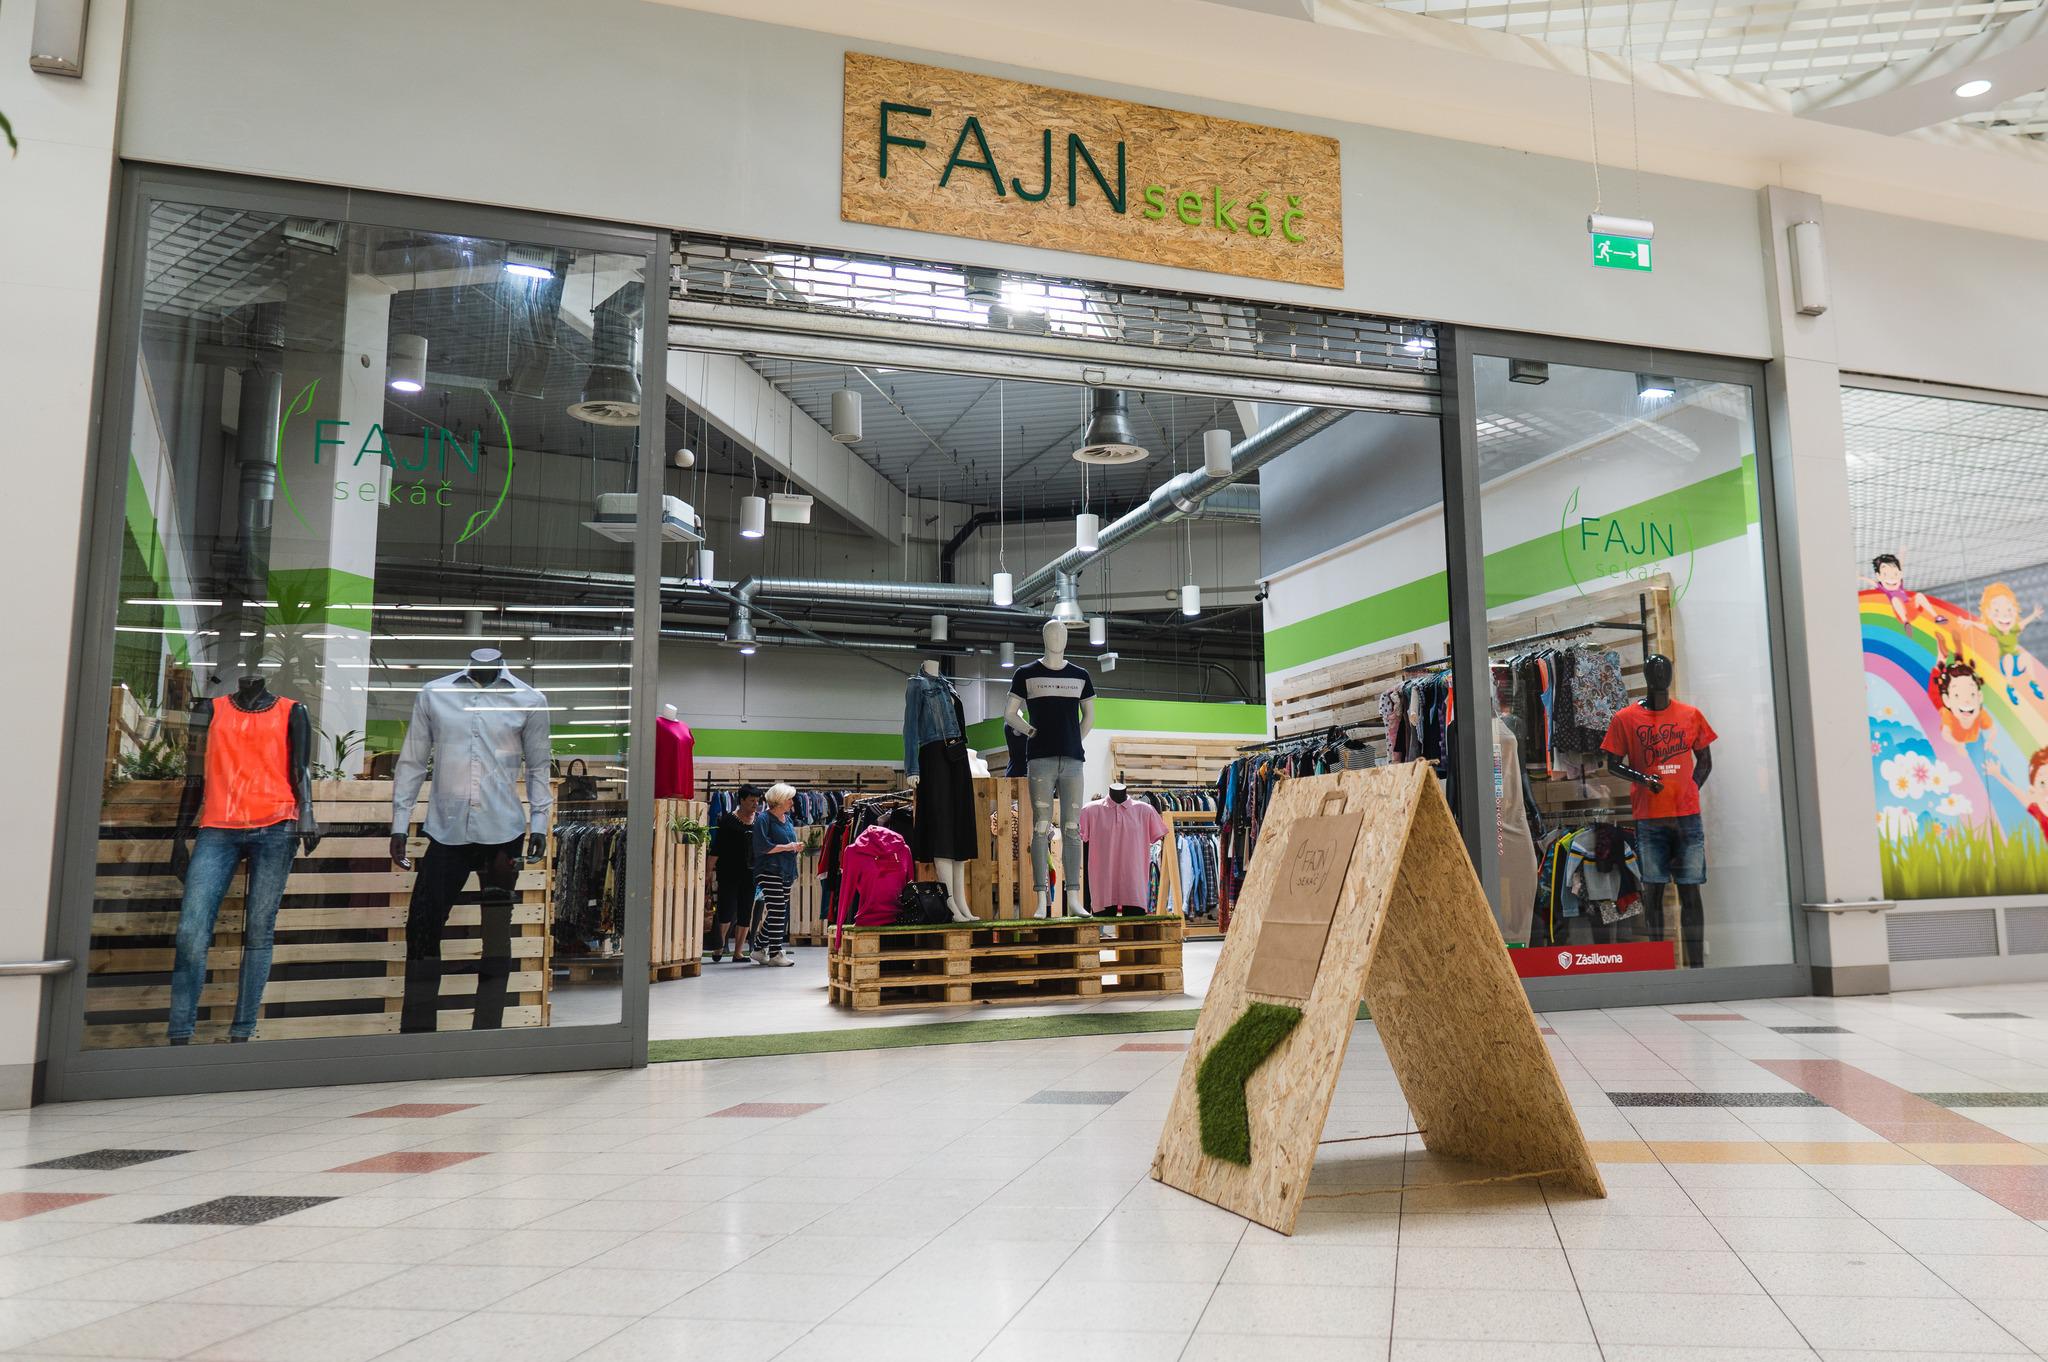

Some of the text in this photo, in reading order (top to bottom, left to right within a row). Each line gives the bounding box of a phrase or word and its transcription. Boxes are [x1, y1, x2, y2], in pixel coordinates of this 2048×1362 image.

[880, 101, 1306, 243] FAJN sekáč
[314, 419, 480, 474] FAJN
[334, 479, 454, 506] sekáč
[1581, 517, 1674, 556] FAJN
[1636, 725, 1661, 745] The
[1575, 953, 1623, 966] Zásilkovna
